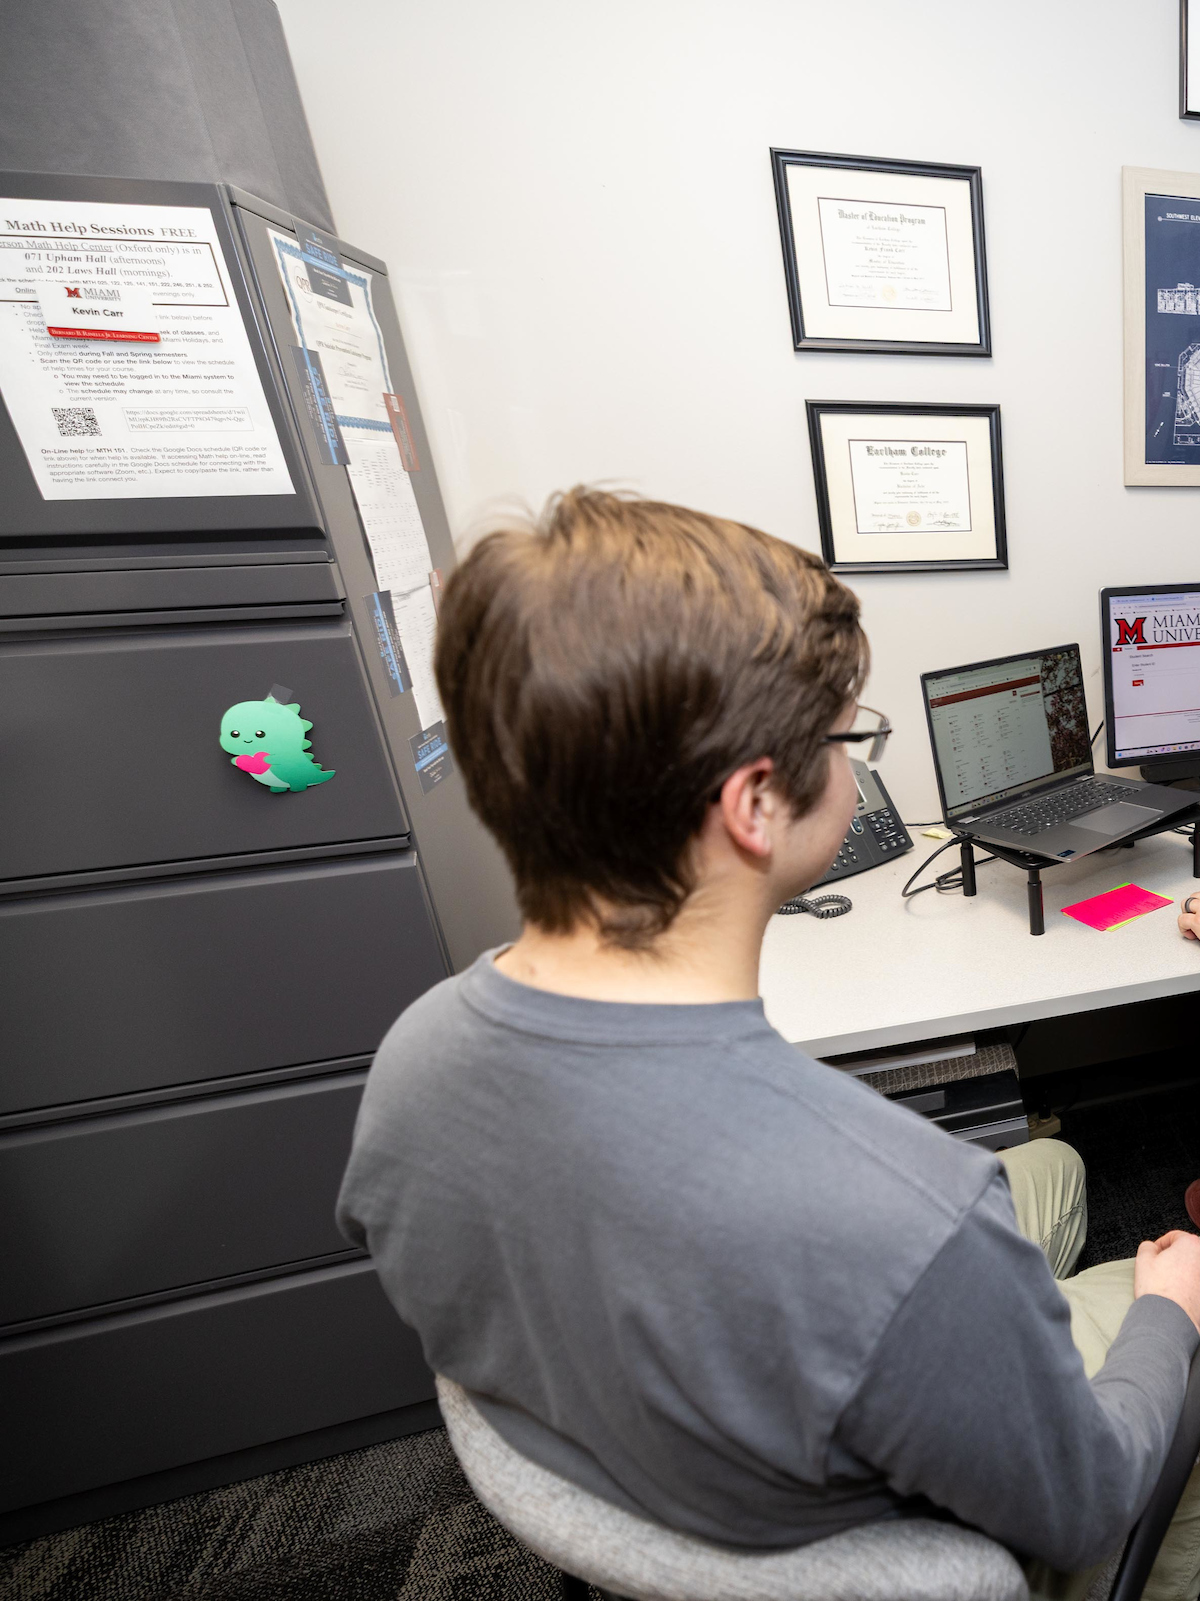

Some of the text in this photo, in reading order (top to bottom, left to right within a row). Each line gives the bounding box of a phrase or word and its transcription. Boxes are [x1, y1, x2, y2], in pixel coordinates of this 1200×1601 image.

[1166, 212, 1190, 220] SOUTHWEST
[5, 220, 197, 238] Math Help Sessions FREE
[26, 241, 52, 249] Math
[55, 242, 78, 251] Help
[81, 243, 113, 251] Center
[115, 243, 153, 253] (Oxford
[155, 245, 180, 255] only)
[182, 246, 190, 254] is
[46, 253, 82, 263] Upham
[86, 255, 107, 263] Hall
[109, 256, 166, 266] (afternoons)
[305, 243, 338, 267] SAFE RIDE
[26, 265, 44, 273] and
[96, 267, 117, 275] Hall
[119, 268, 173, 278] (mornings).
[84, 287, 120, 297] MIAMI
[72, 307, 124, 317] Kevin Carr
[865, 445, 948, 459] Earlham College
[417, 737, 442, 760] SAFE RIDE
